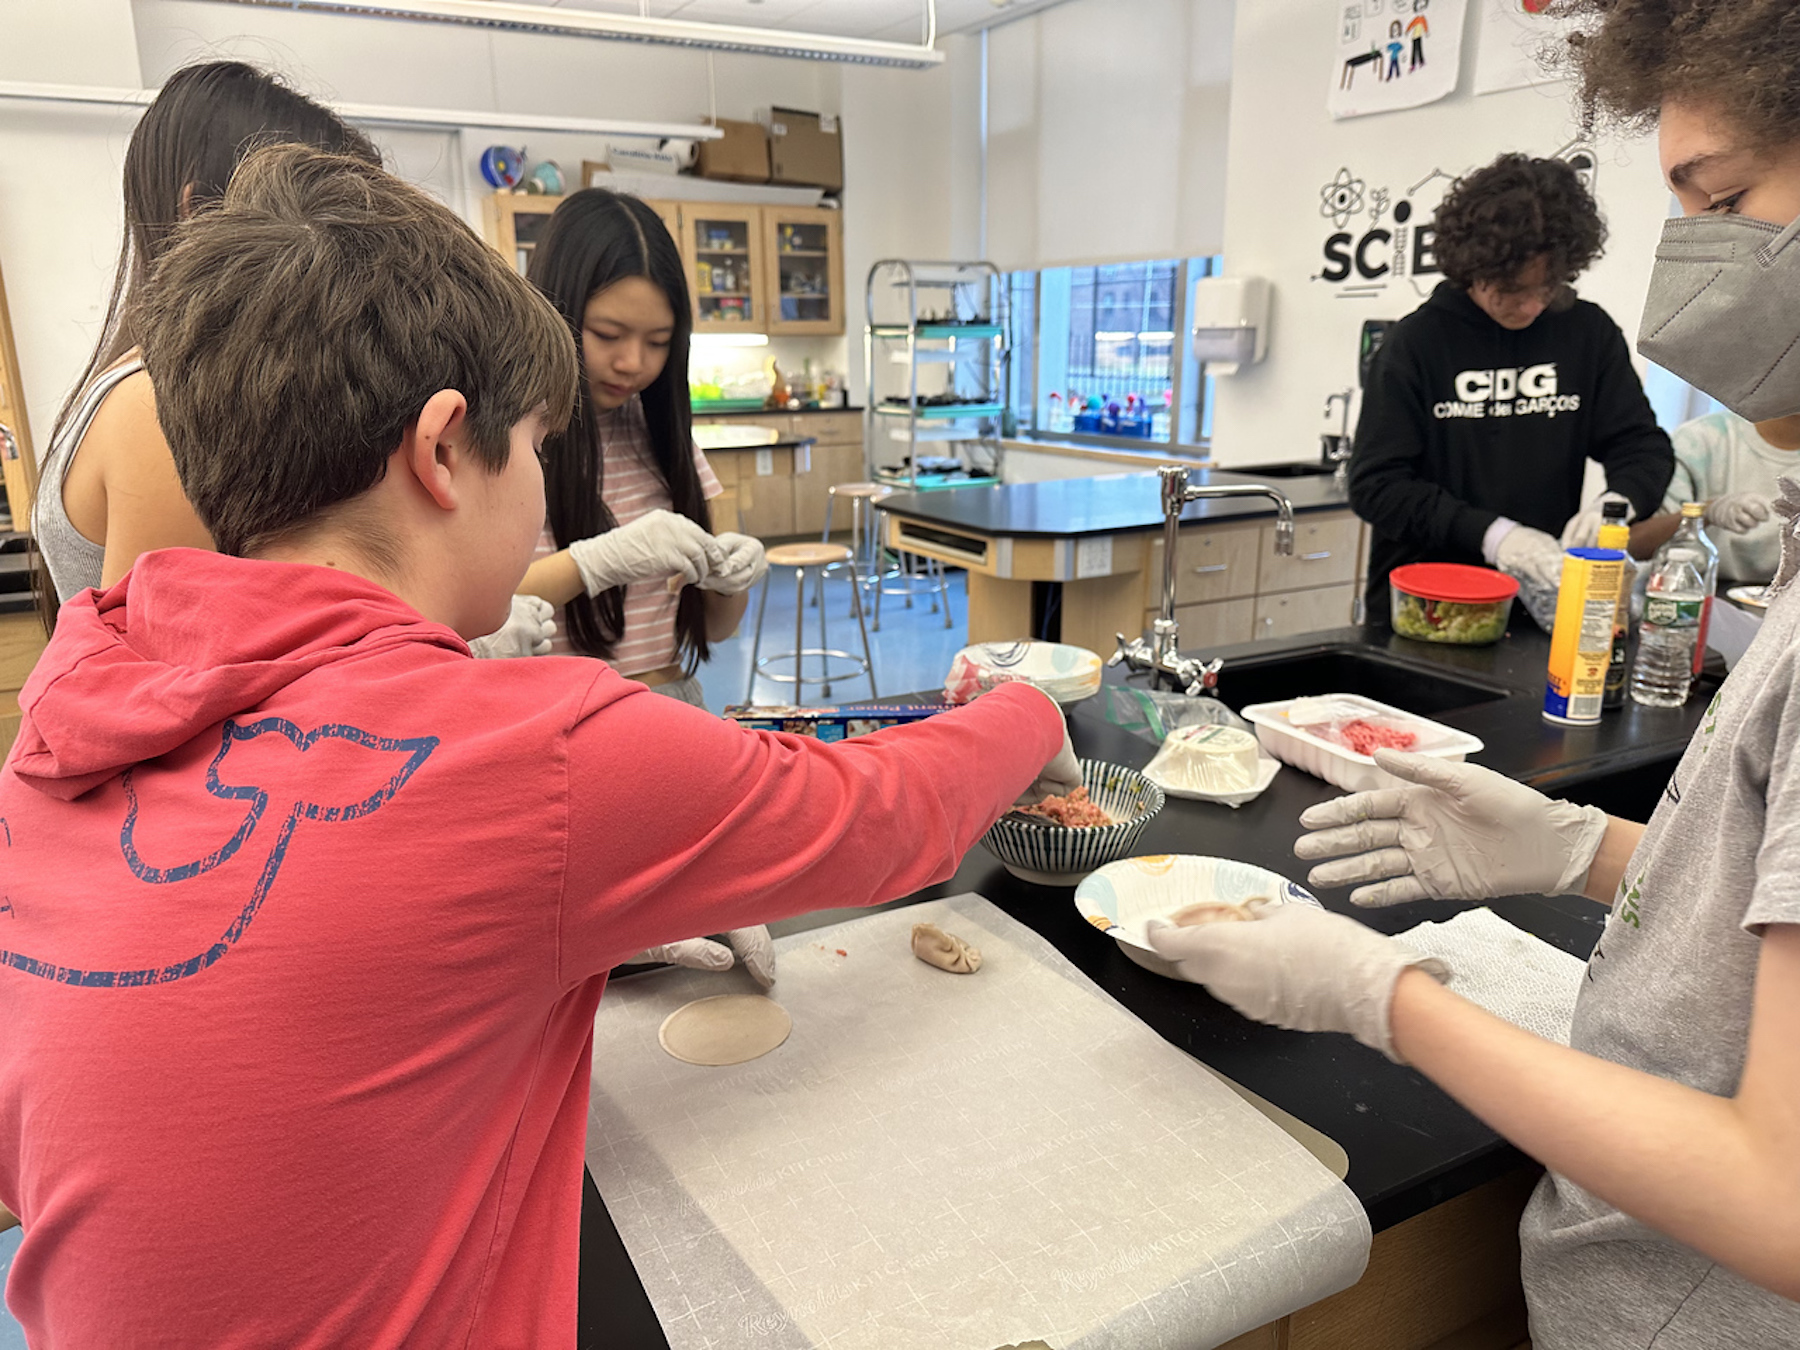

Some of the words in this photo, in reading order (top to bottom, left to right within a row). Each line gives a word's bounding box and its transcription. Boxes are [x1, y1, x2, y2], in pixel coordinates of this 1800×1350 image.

[1455, 362, 1557, 402] CDG
[1051, 1243, 1152, 1293] Reynolds
[1149, 1214, 1236, 1255] KITCHENS
[738, 1284, 854, 1338] Reynolds
